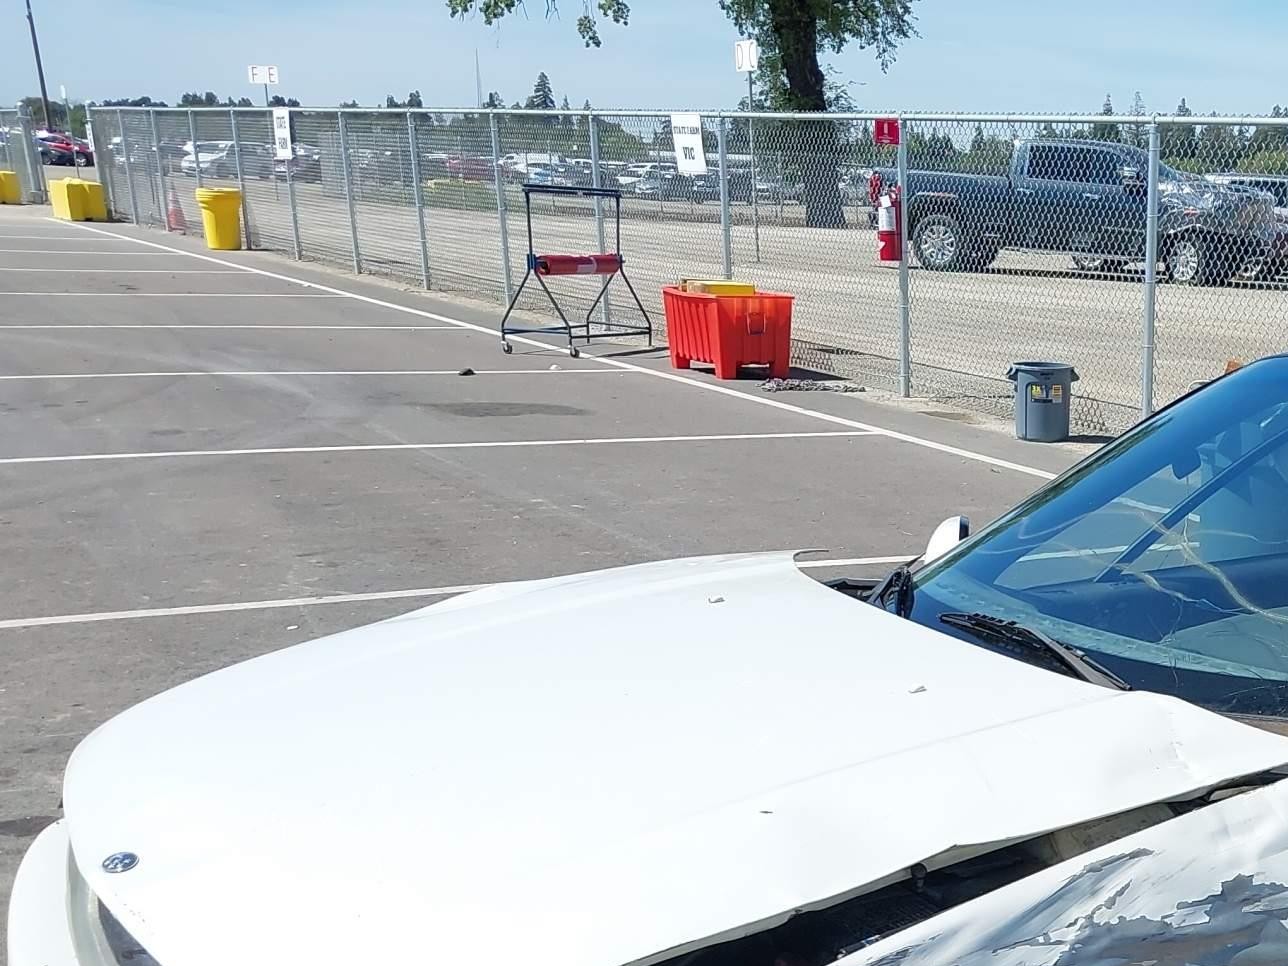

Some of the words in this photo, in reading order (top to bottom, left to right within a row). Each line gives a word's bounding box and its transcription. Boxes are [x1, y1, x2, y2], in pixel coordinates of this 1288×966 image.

[251, 66, 259, 82] F
[267, 66, 277, 83] E
[682, 146, 696, 161] VIC
